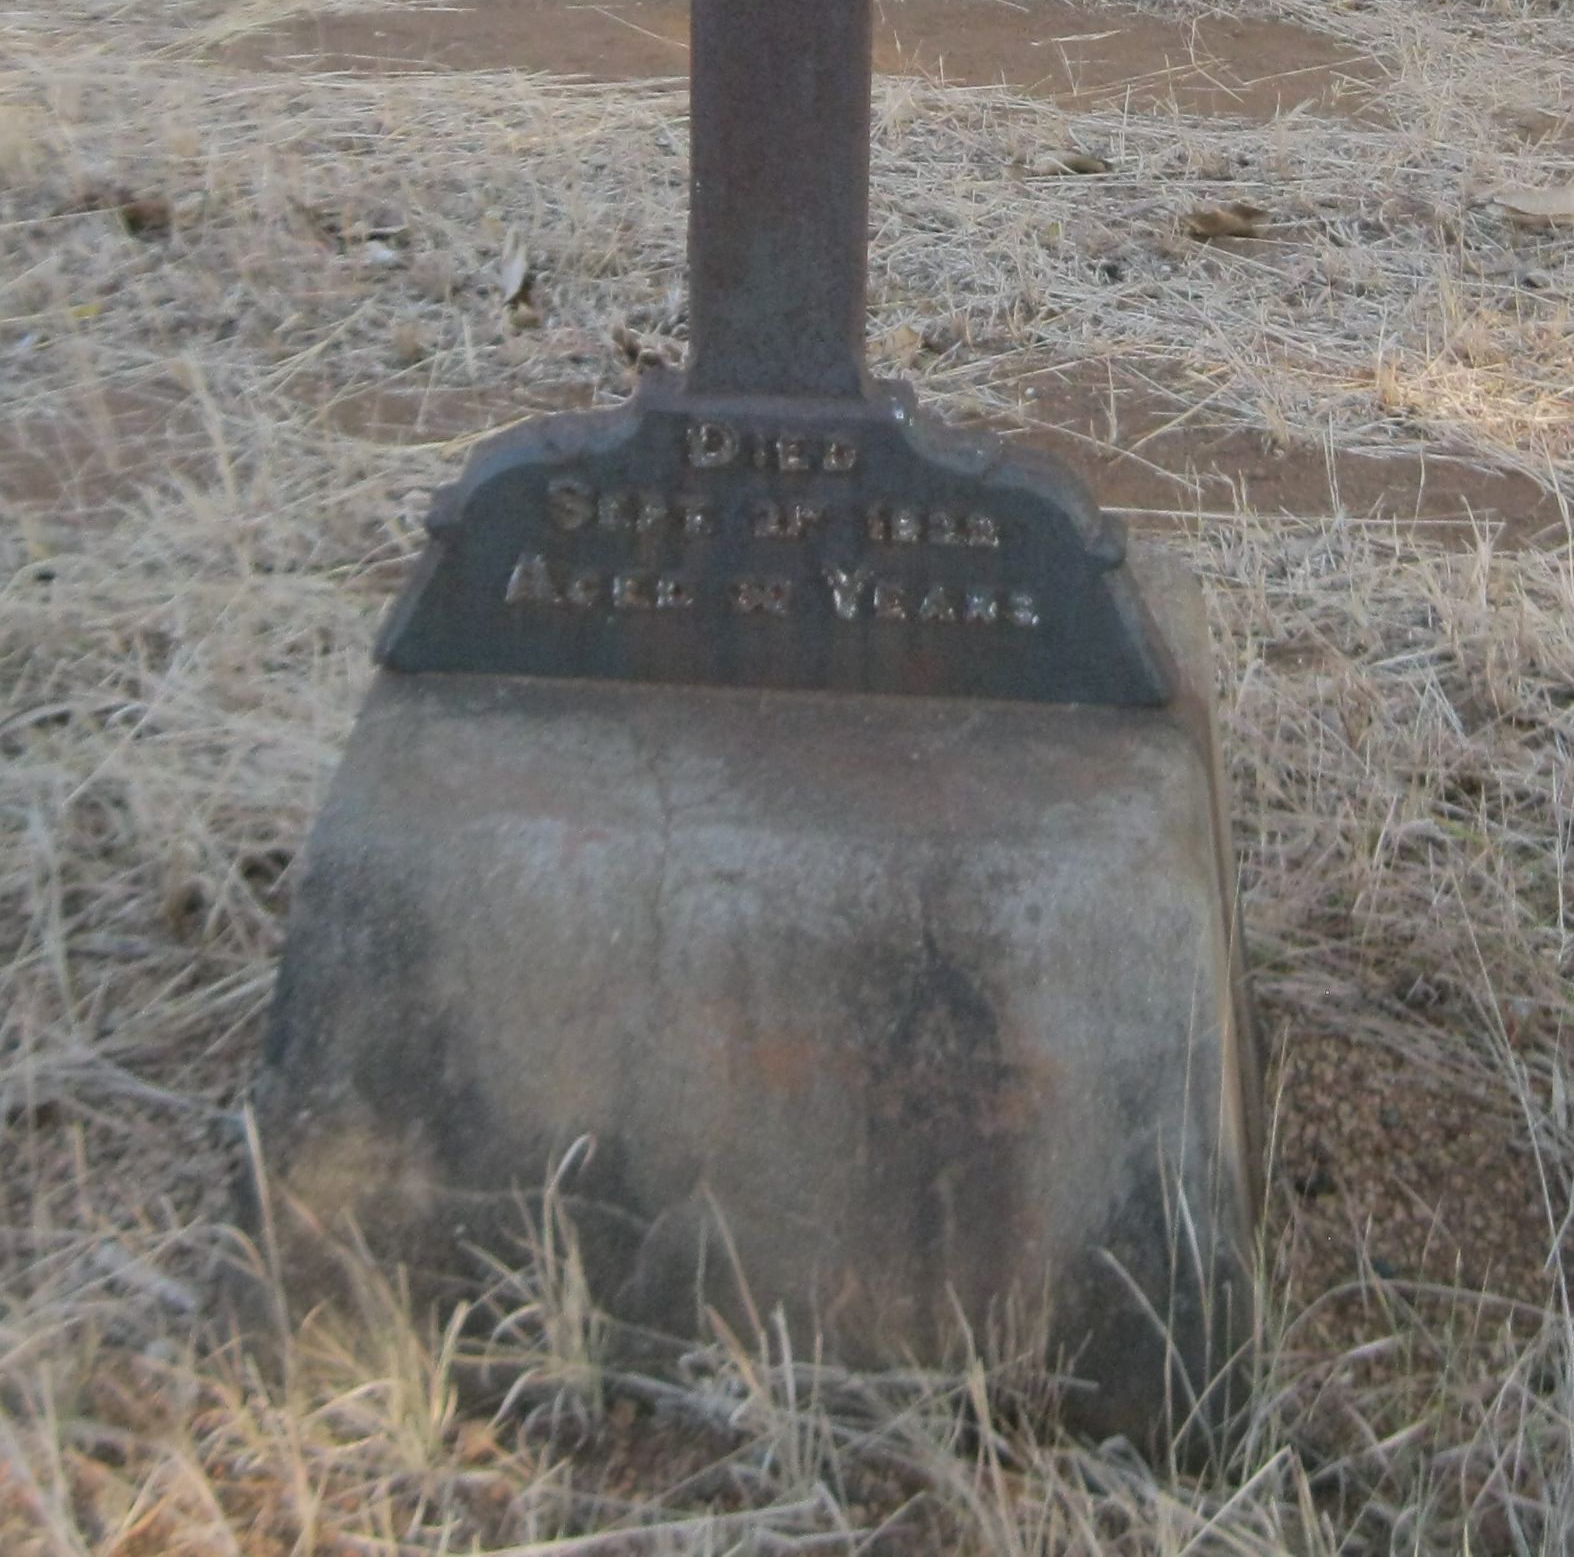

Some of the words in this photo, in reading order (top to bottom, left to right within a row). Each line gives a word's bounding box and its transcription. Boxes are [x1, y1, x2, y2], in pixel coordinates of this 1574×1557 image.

[686, 422, 858, 471] DIED
[504, 552, 696, 609] AGED
[821, 561, 1040, 627] YEARS
